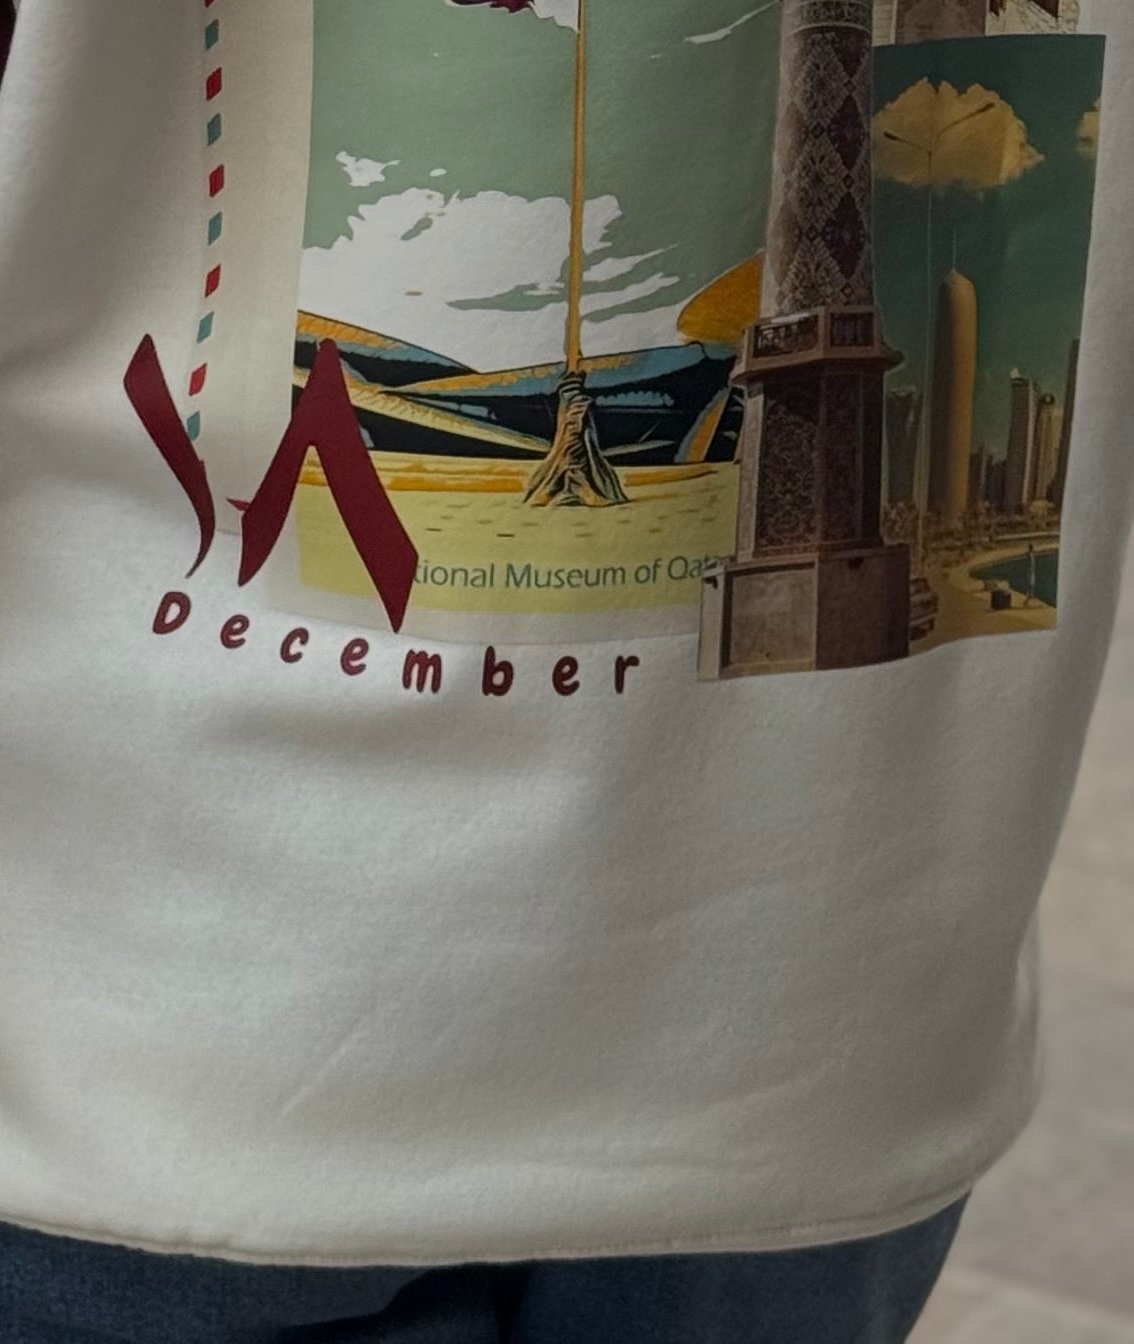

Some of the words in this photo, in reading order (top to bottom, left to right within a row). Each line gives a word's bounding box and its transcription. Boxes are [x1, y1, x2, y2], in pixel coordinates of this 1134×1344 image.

[414, 559, 495, 589] ional
[505, 562, 626, 590] Museum
[633, 557, 662, 584] of
[152, 590, 641, 698] December
